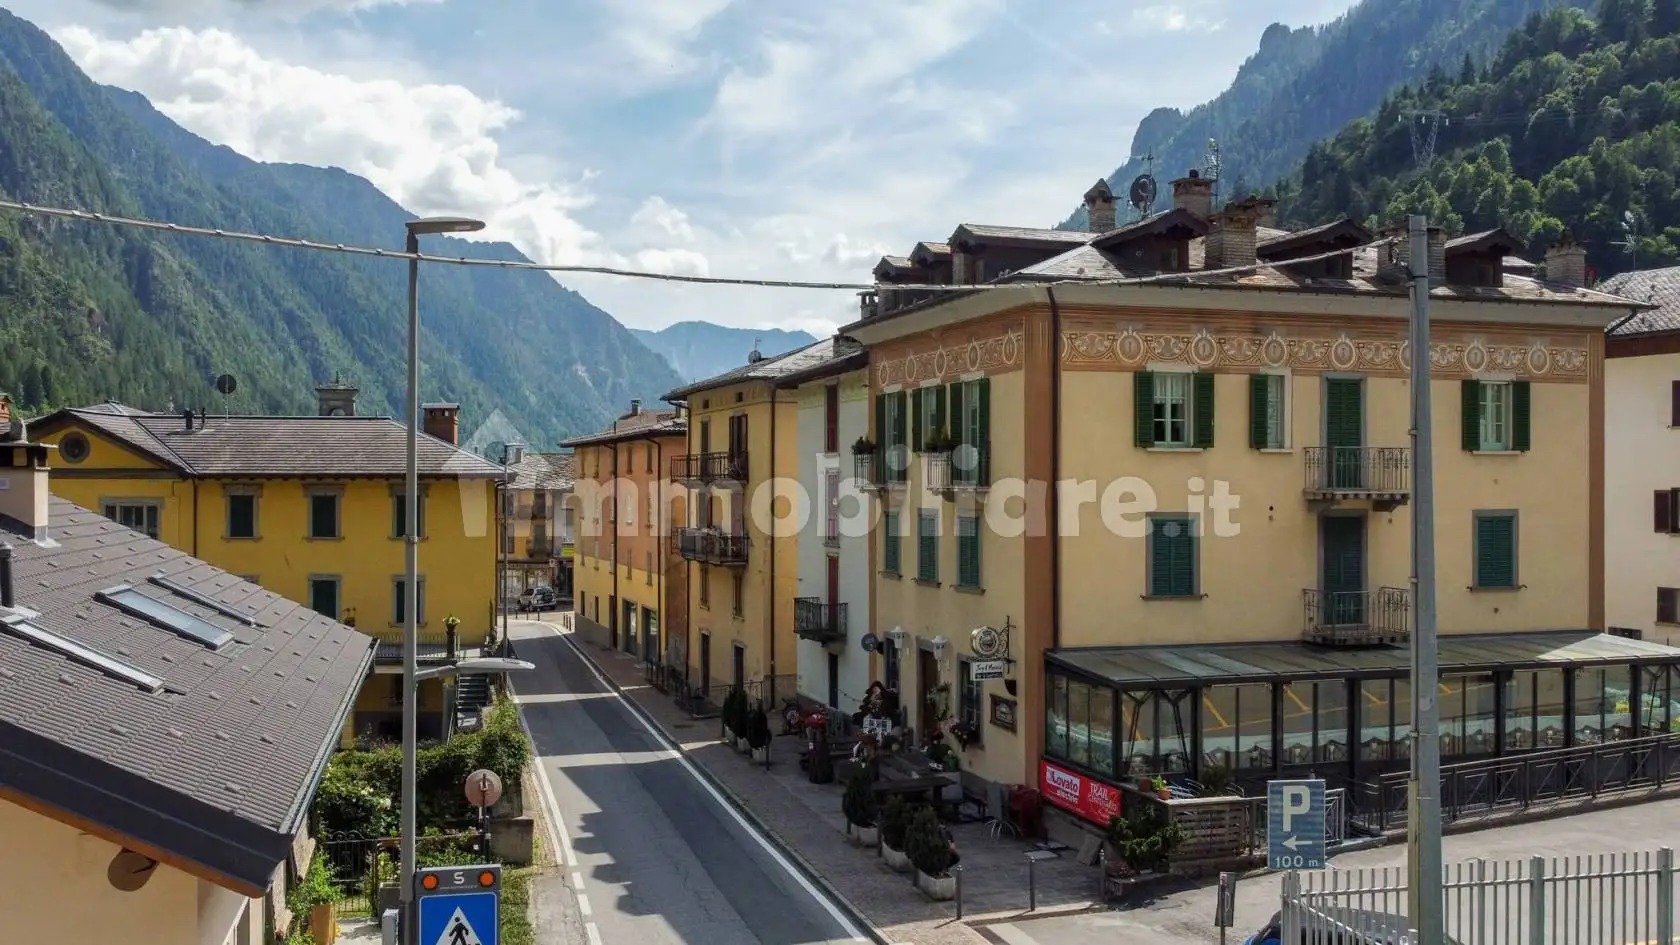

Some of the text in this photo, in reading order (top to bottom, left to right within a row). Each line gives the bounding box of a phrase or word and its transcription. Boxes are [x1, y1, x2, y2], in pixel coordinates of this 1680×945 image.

[1090, 783, 1109, 800] TRAIL
[1282, 785, 1311, 832] P
[1275, 855, 1319, 868] 100 m
